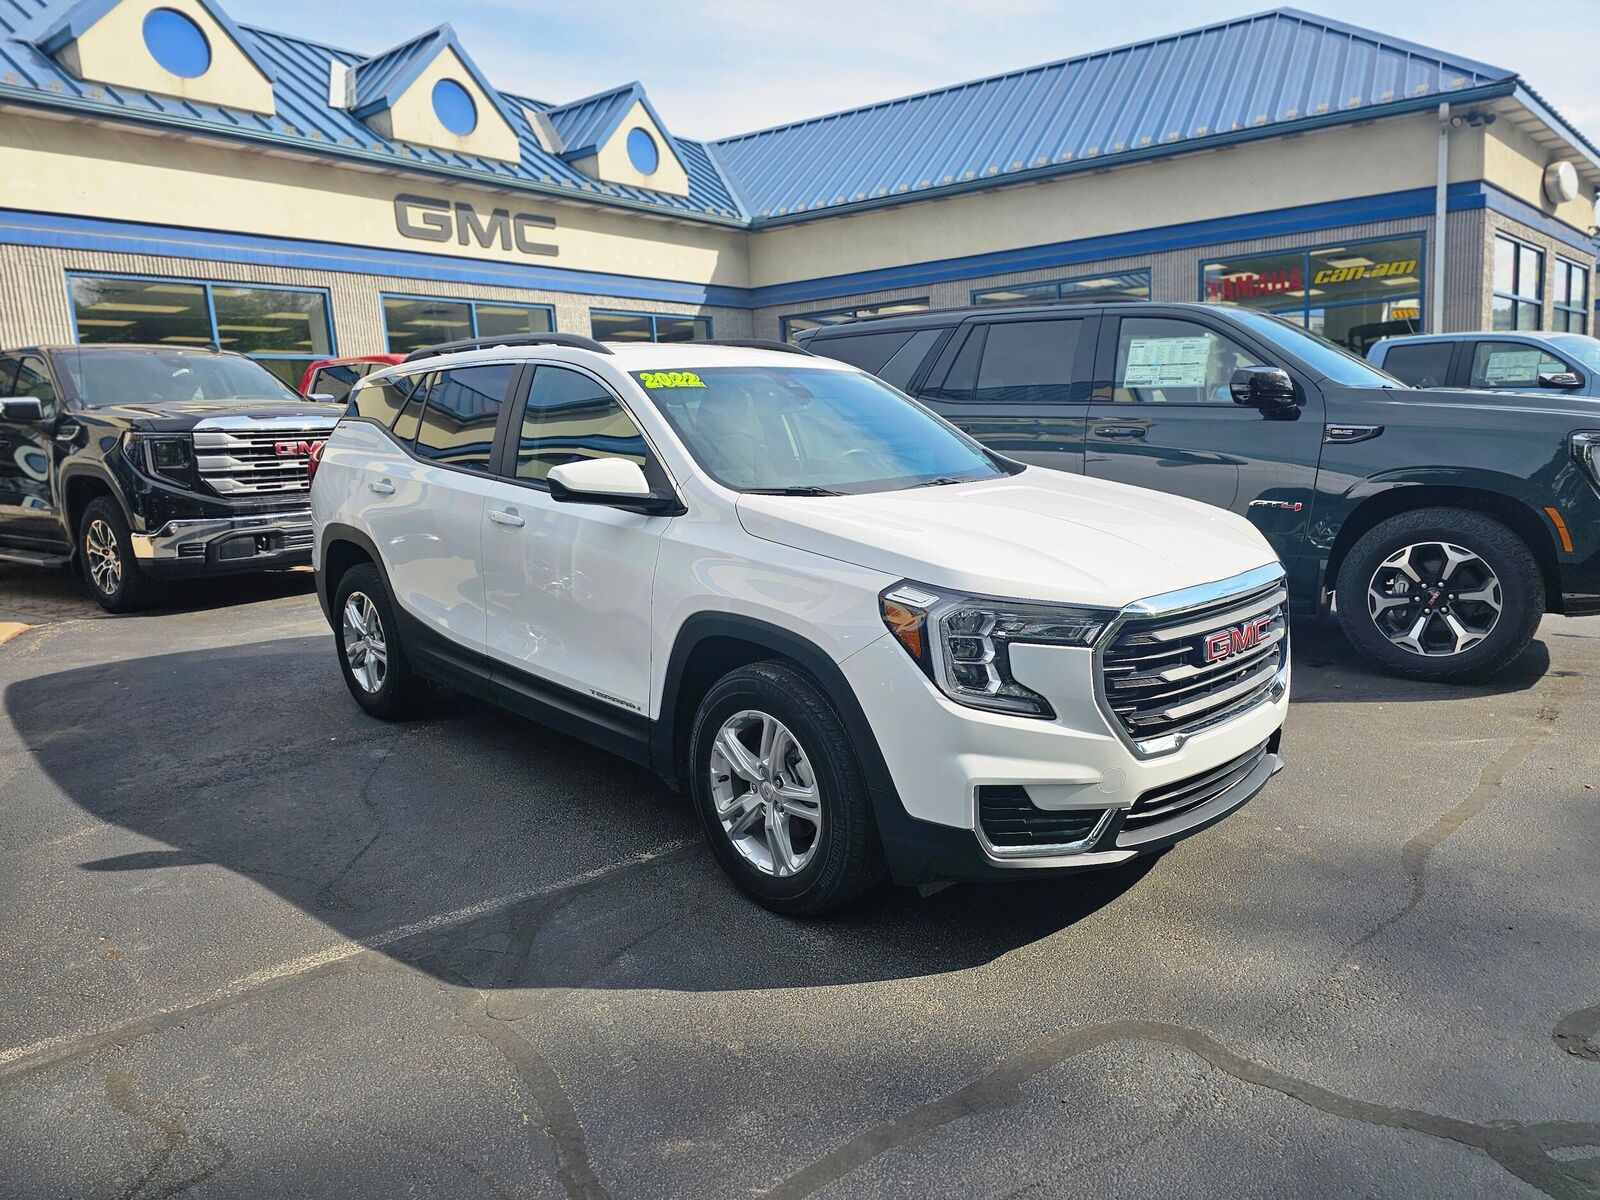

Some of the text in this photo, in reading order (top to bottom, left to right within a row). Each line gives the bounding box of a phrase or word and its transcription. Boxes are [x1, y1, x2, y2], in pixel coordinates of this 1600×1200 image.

[394, 193, 559, 257] GMC
[1206, 267, 1303, 301] YAMAHA
[1314, 259, 1417, 285] can-am
[639, 371, 707, 389] 2022
[274, 440, 327, 456] GM
[1203, 615, 1271, 662] GMC
